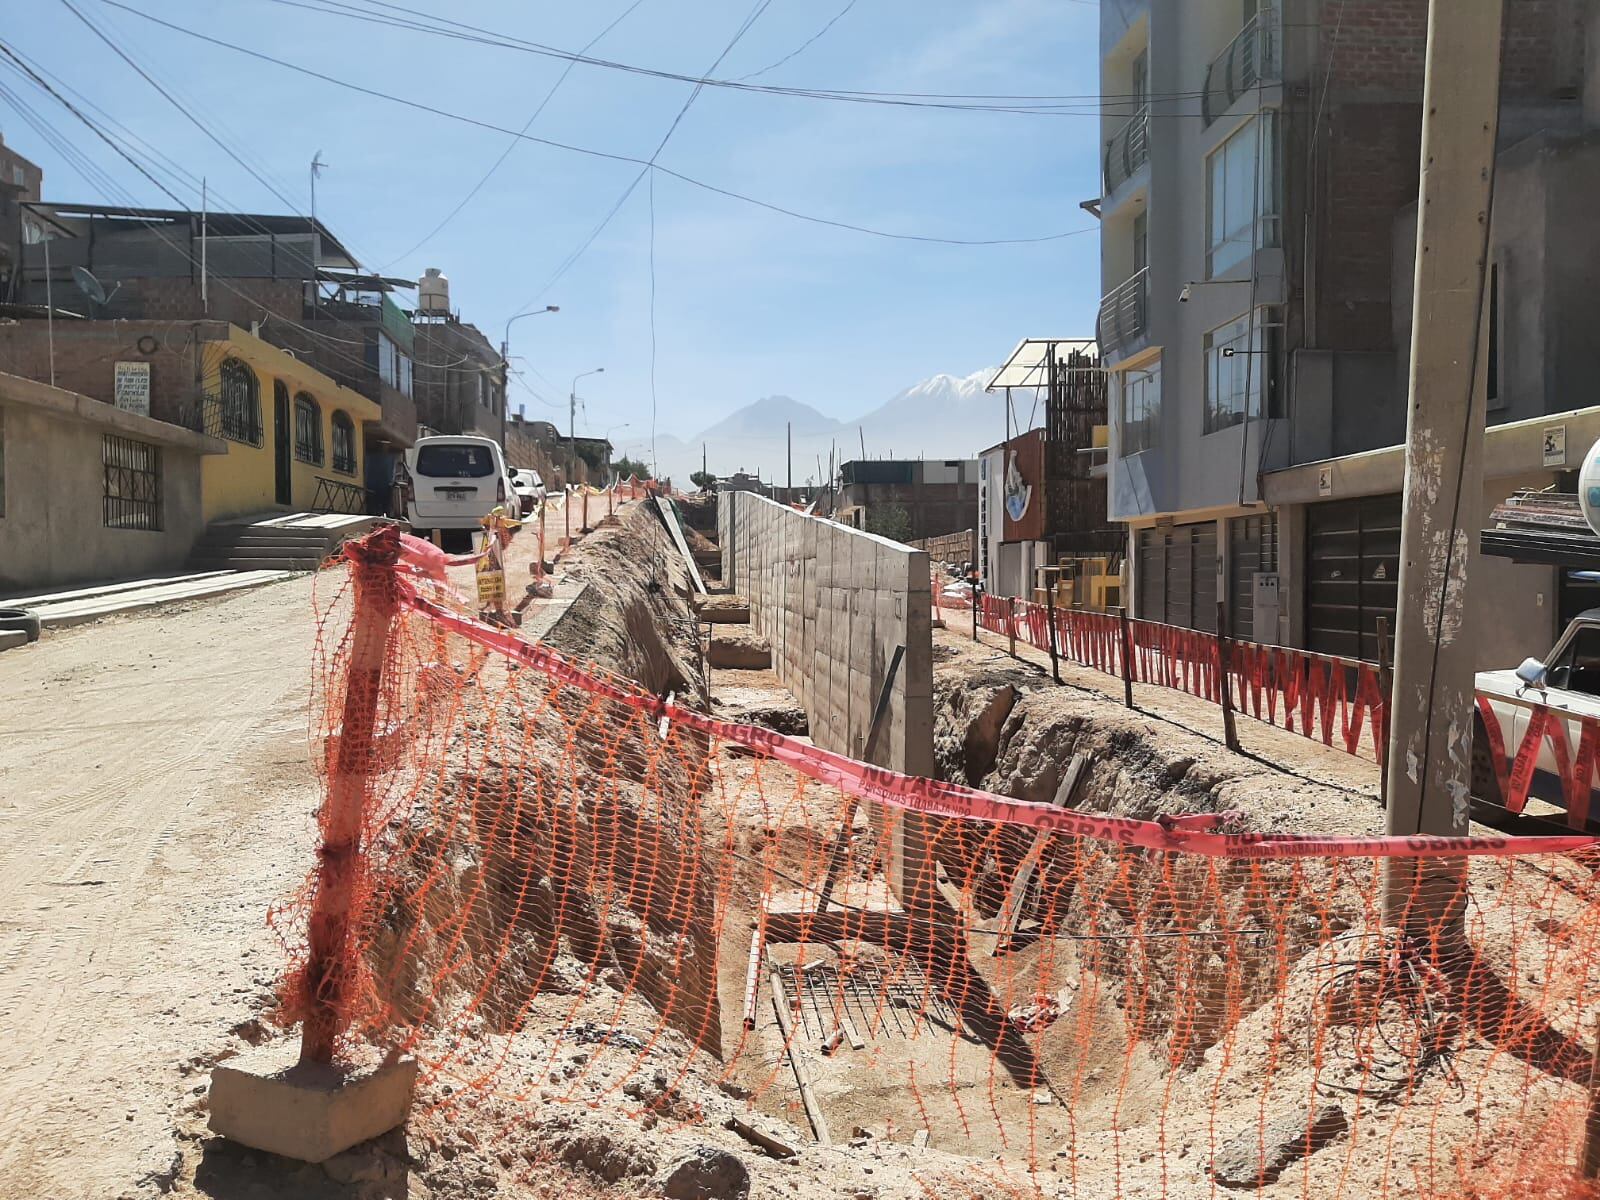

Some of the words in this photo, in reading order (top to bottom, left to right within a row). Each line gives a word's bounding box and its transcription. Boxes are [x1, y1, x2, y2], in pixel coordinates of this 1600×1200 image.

[858, 779, 907, 806] PERSONAS
[1034, 815, 1136, 843] OBRAS
[1225, 846, 1276, 857] PERSONAS
